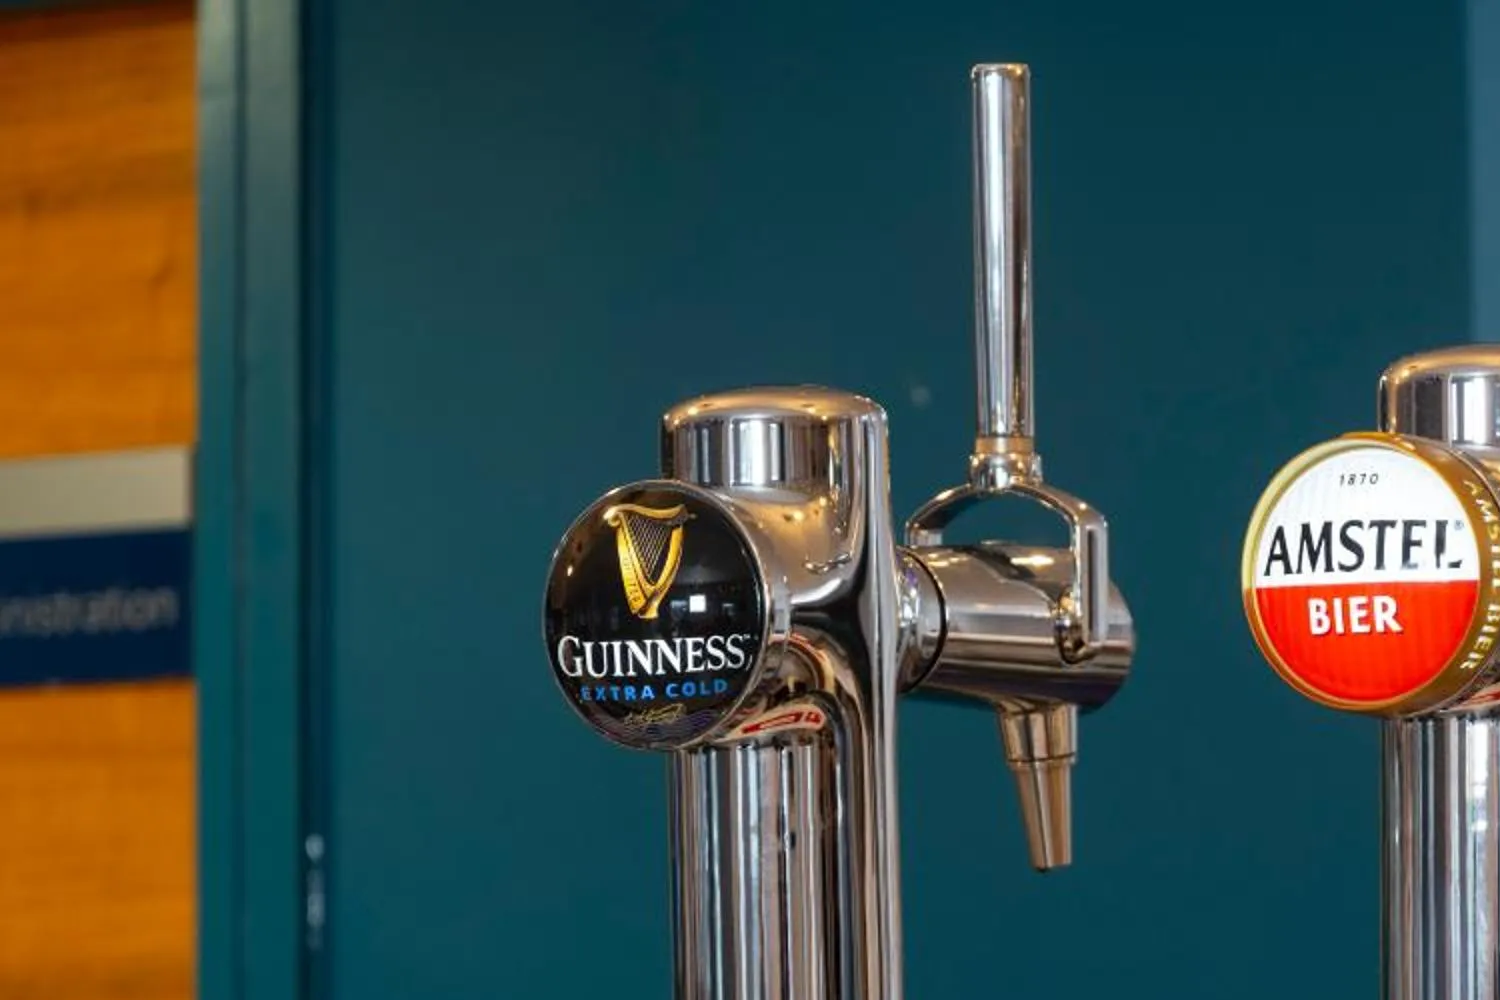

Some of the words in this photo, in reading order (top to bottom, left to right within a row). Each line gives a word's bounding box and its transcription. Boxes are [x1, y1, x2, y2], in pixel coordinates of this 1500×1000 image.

[1339, 473, 1380, 487] 1870
[1263, 519, 1463, 576] AMSTEL
[1308, 594, 1404, 636] BIER
[557, 634, 746, 678] GUINNESS
[580, 683, 656, 701] EXTRA
[665, 678, 729, 698] COLD
